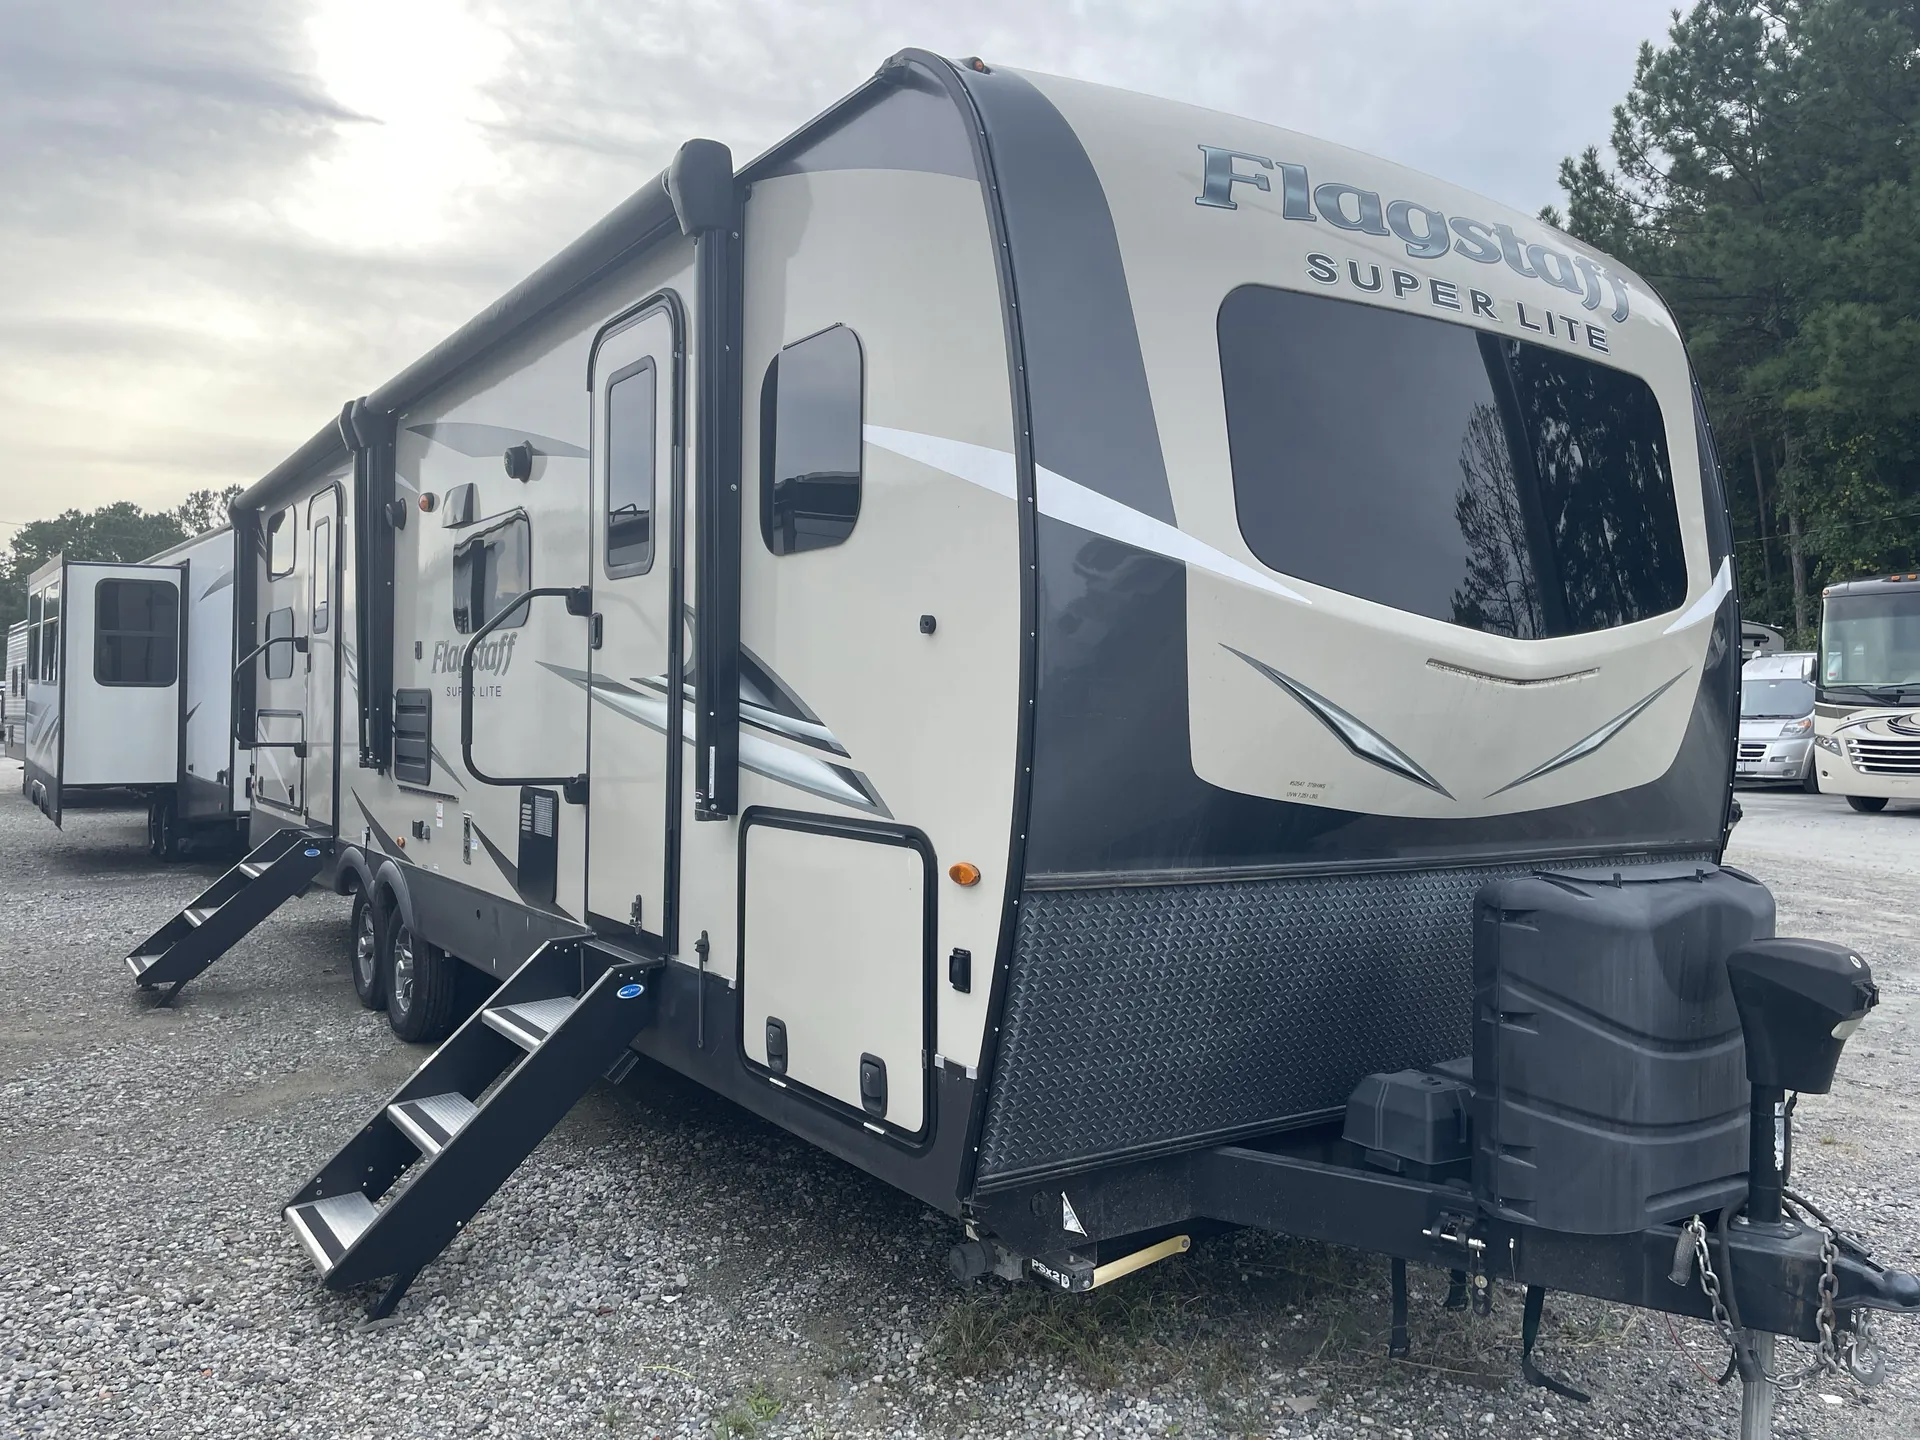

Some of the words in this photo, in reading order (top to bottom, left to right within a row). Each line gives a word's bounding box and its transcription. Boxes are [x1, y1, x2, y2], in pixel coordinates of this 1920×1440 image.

[1194, 143, 1629, 324] Flagstaff
[1304, 251, 1502, 324] SUPER
[1515, 300, 1611, 356] LITE
[446, 686, 476, 697] SUPR
[479, 685, 502, 697] LITE
